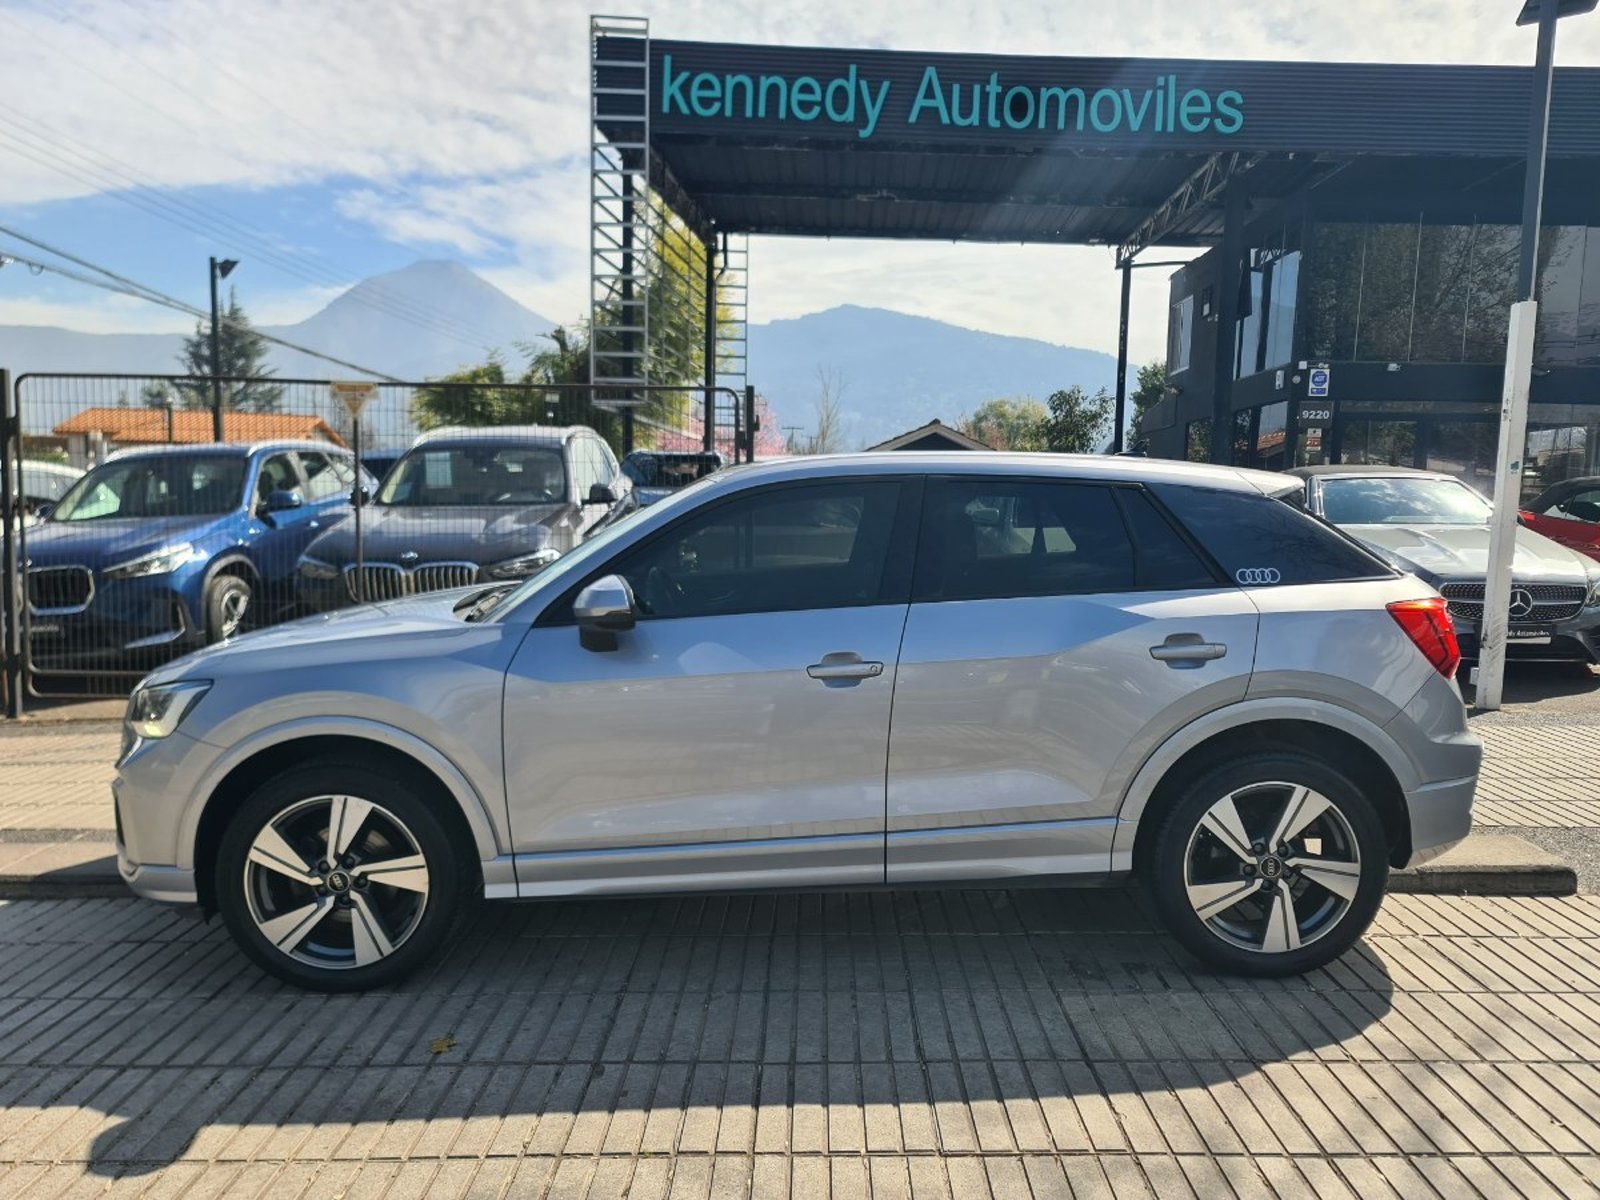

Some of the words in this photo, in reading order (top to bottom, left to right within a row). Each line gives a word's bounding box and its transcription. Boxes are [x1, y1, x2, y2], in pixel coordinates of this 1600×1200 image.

[661, 55, 890, 138] kennedy
[908, 65, 1244, 135] Automoviles
[1302, 410, 1330, 420] 9220
